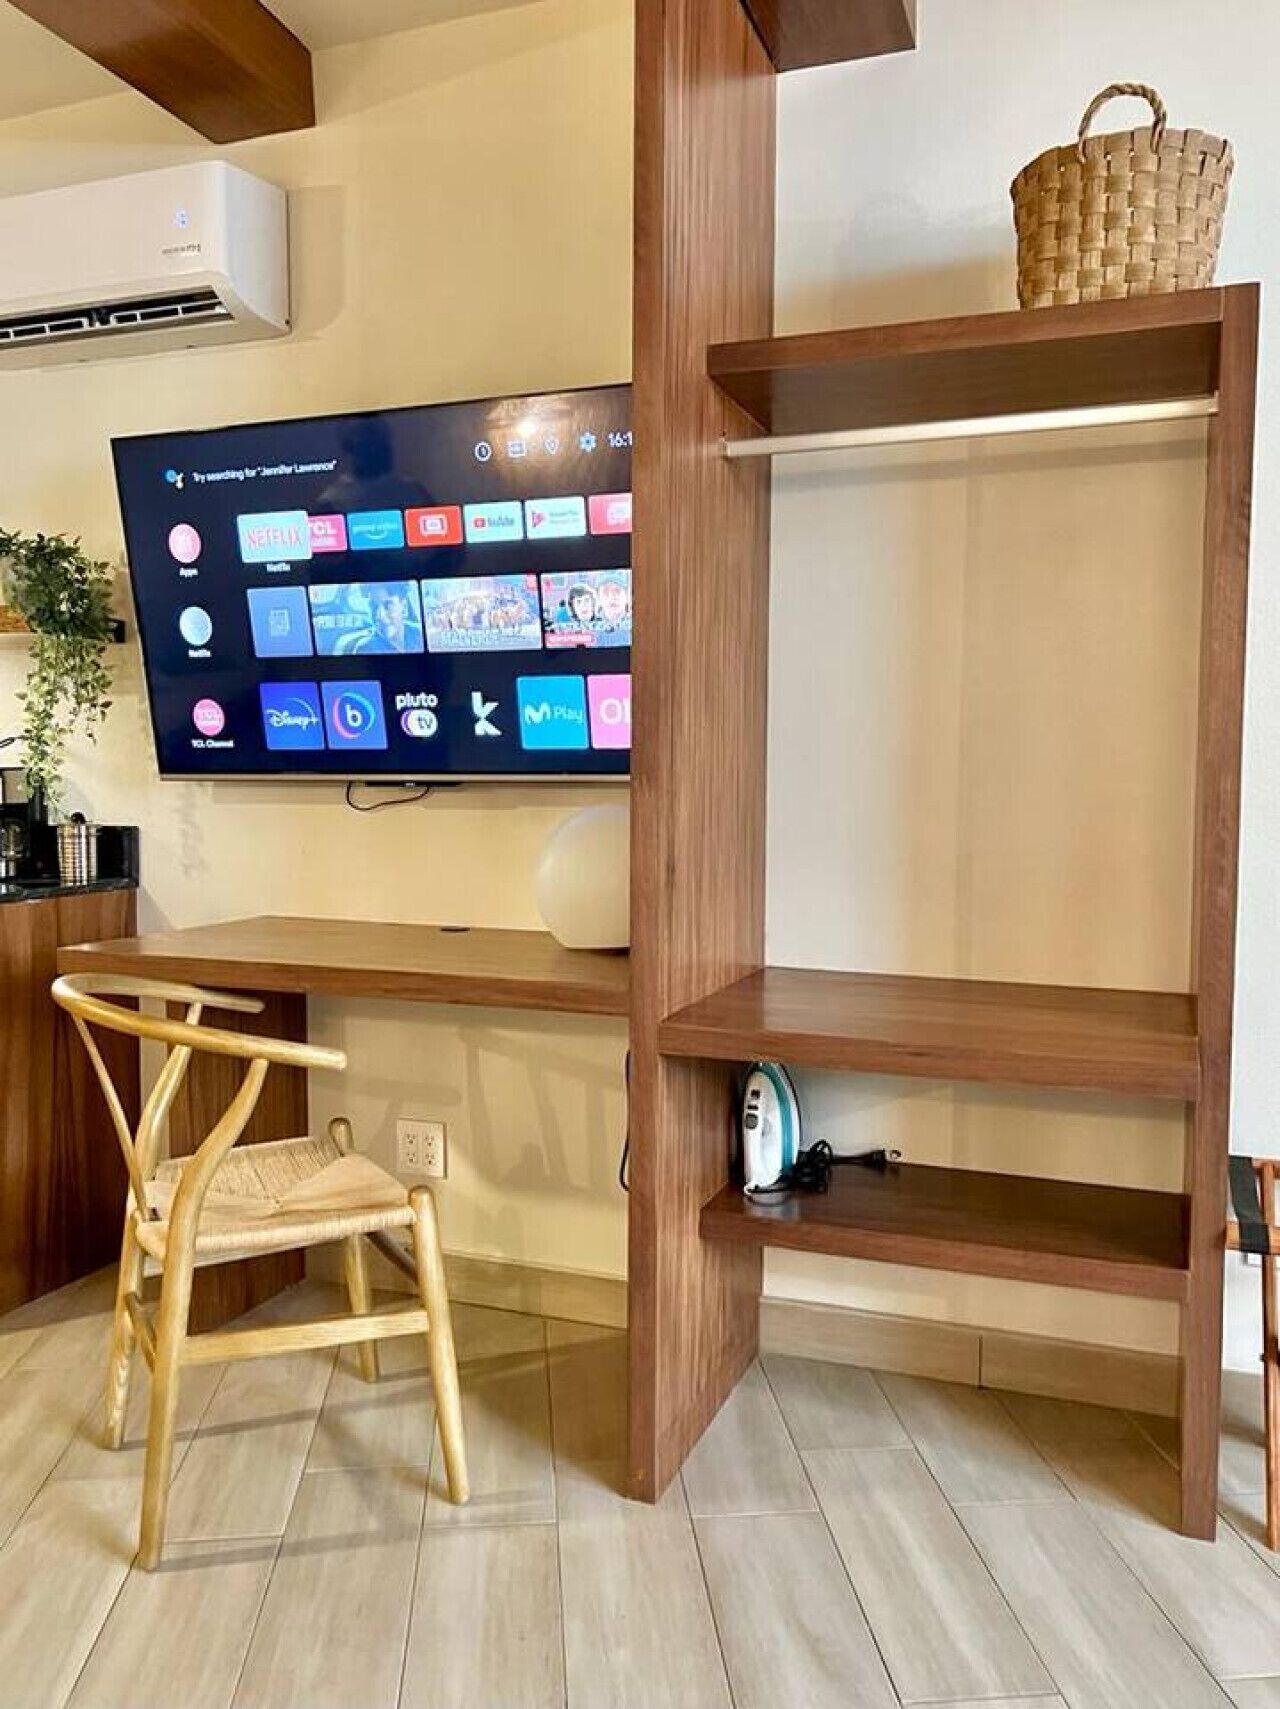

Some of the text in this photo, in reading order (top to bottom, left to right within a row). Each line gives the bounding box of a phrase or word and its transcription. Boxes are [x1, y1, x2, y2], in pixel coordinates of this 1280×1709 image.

[246, 523, 302, 549] NETFLIX
[395, 692, 438, 710] pluto
[344, 703, 362, 727] b
[554, 704, 584, 726] Play
